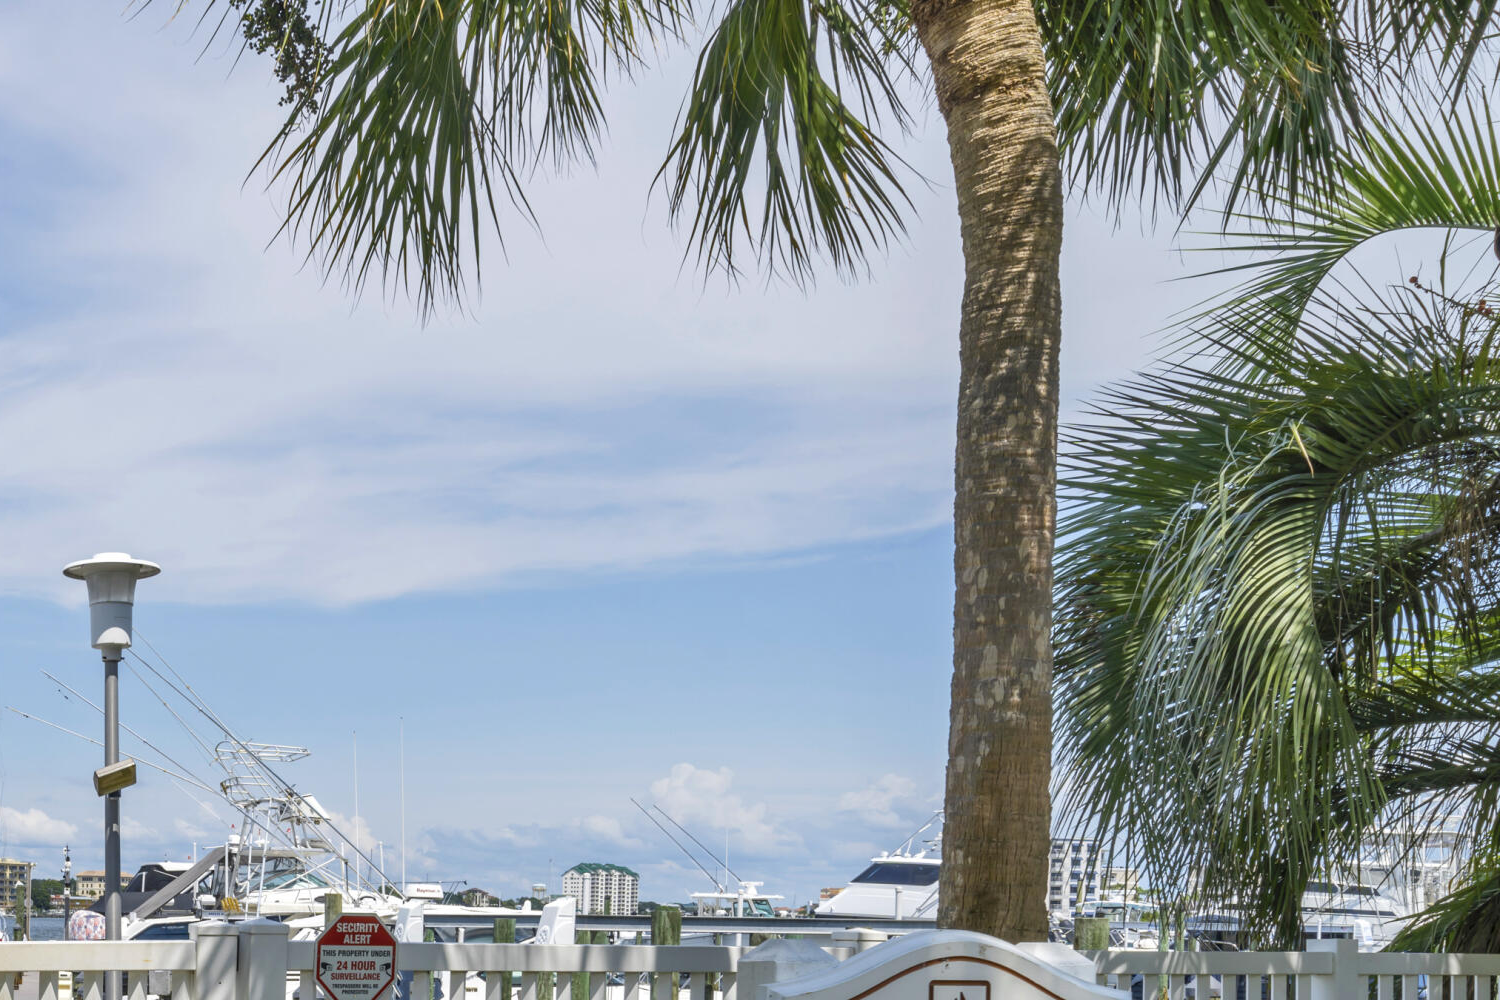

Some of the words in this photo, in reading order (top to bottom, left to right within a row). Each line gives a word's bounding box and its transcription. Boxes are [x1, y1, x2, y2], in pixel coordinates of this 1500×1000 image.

[336, 922, 380, 933] SECURITY
[343, 934, 372, 945] ALERT
[322, 949, 337, 957] THIS
[338, 949, 369, 957] PROPERTY
[336, 961, 348, 971] 24
[351, 961, 376, 971] HOUR
